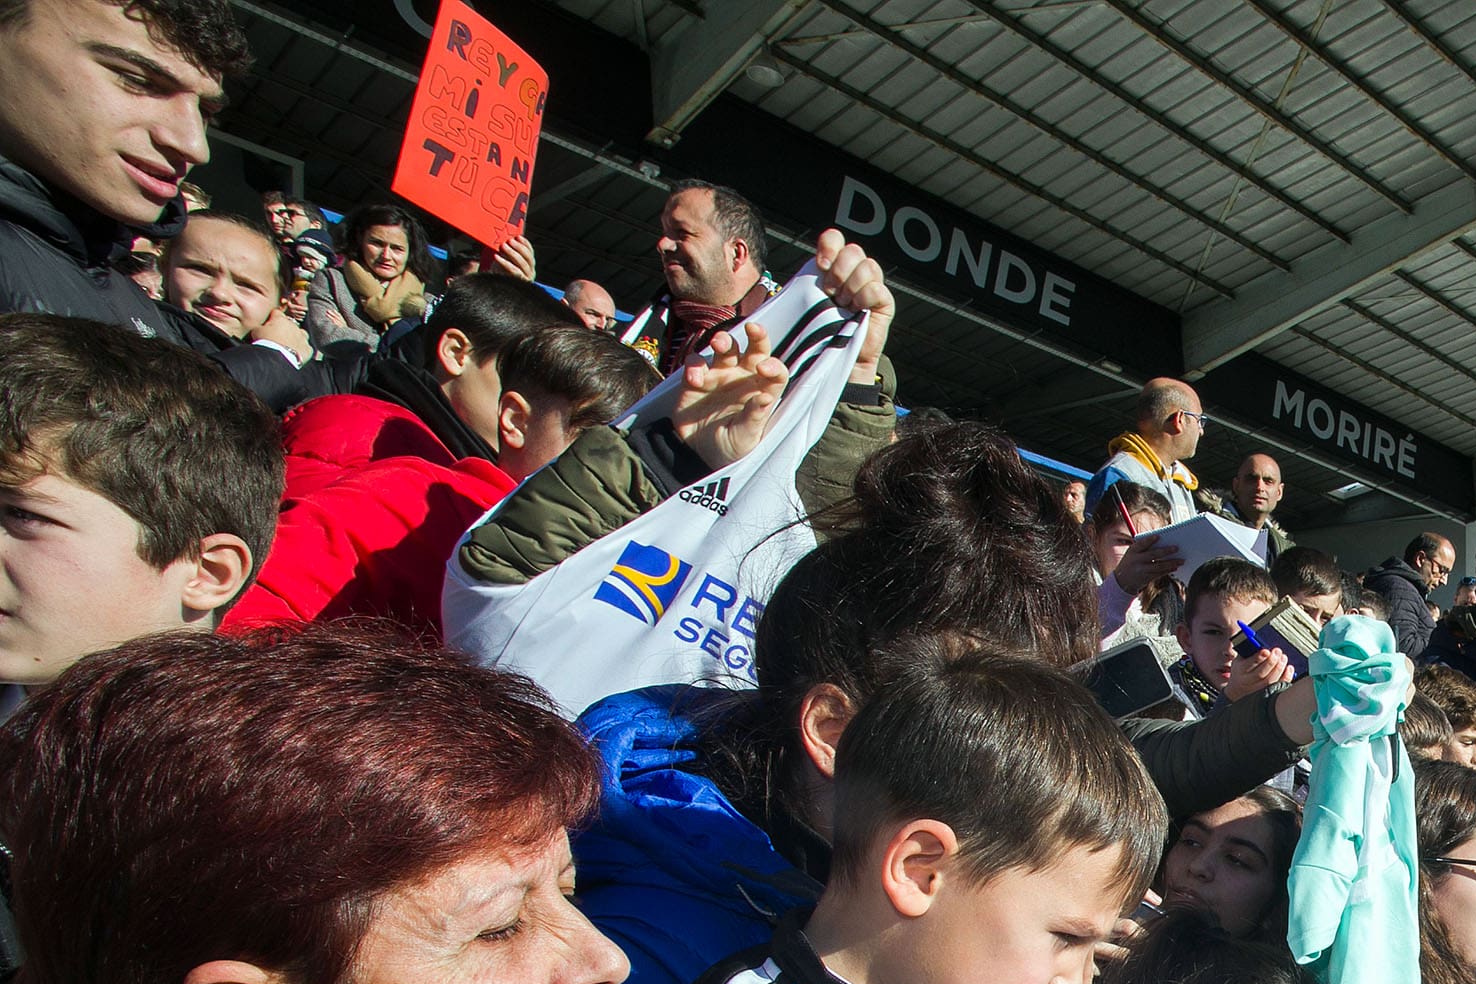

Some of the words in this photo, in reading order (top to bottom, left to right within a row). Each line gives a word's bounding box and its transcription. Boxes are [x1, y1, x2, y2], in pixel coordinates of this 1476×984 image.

[447, 19, 519, 89] REY
[488, 104, 540, 159] SU
[834, 175, 1077, 326] DONDE
[1272, 379, 1418, 479] MORIRÉ
[679, 490, 728, 517] addas
